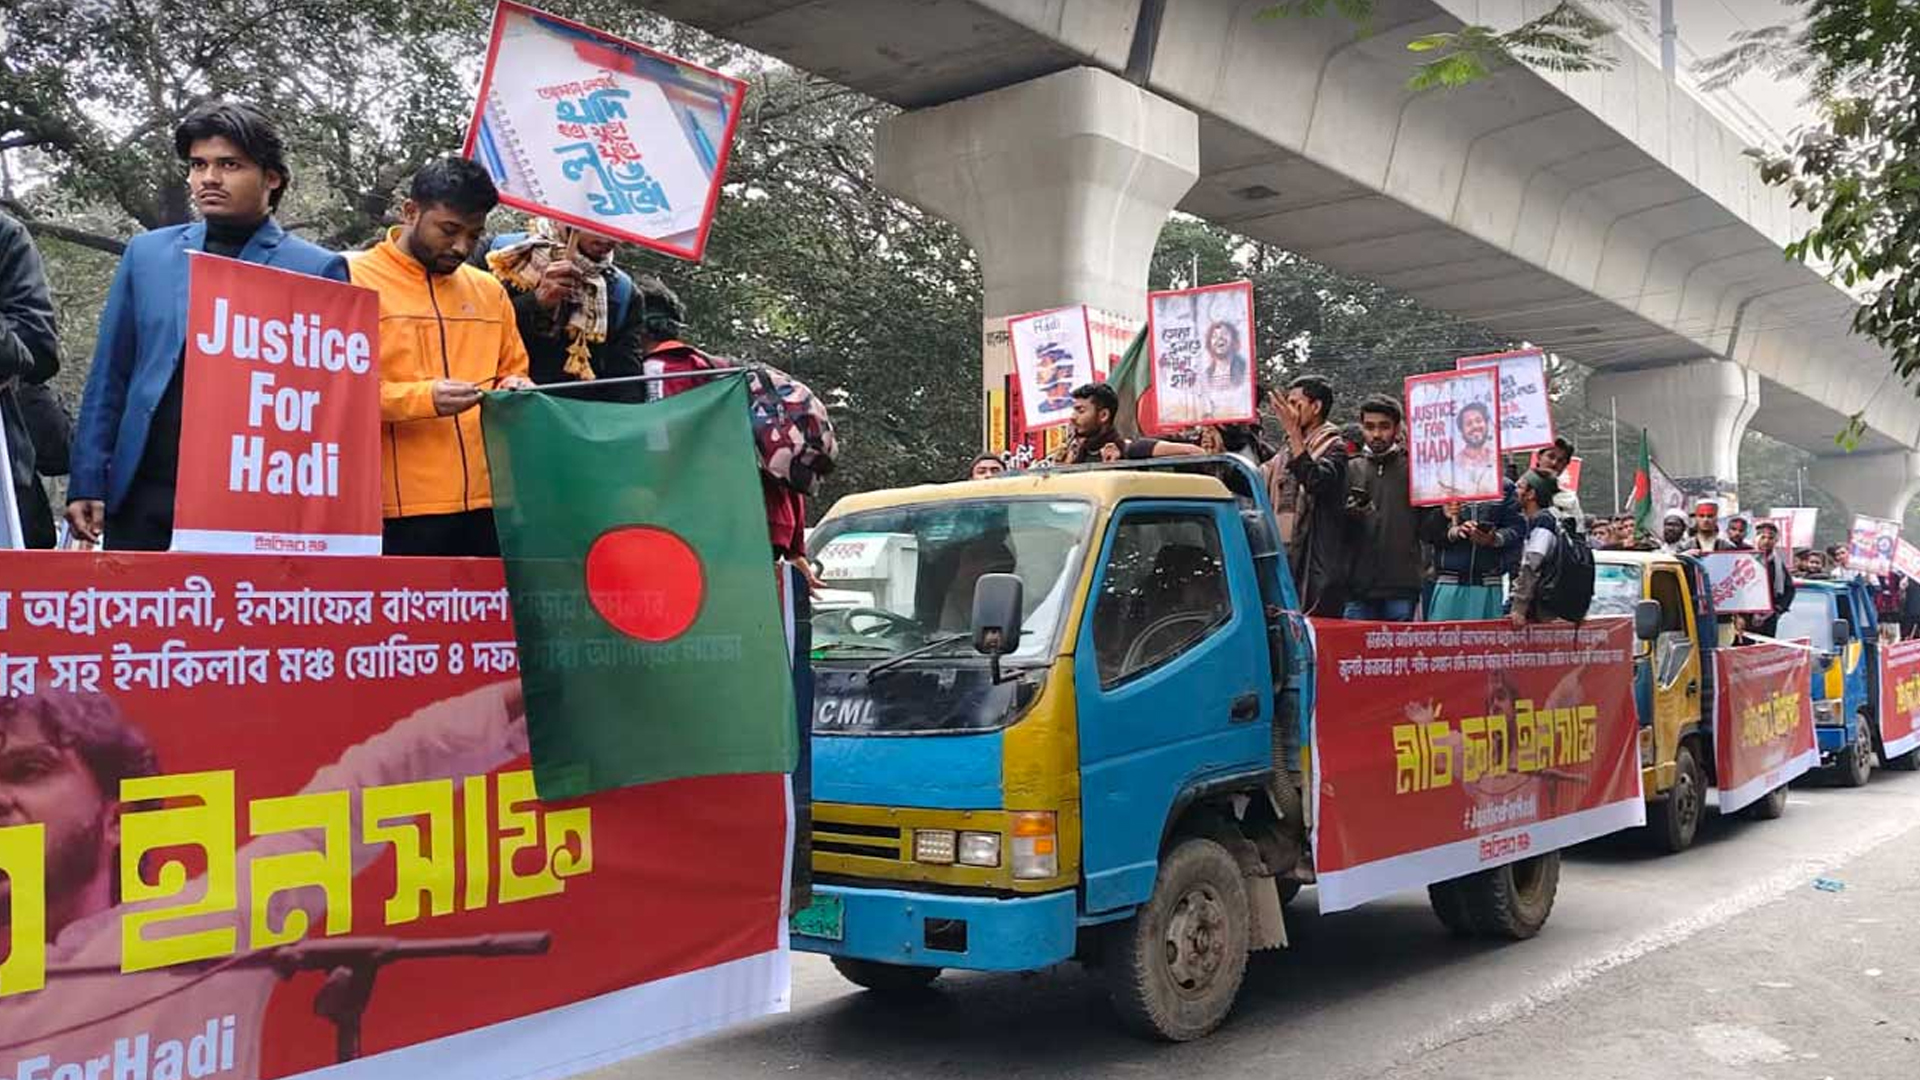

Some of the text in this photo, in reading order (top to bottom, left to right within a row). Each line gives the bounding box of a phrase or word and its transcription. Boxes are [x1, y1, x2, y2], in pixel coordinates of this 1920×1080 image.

[196, 297, 371, 374] Justice
[248, 370, 321, 433] For
[1412, 400, 1458, 423] JUSTICE
[1424, 421, 1446, 438] FOR
[229, 434, 341, 498] Hadi
[1415, 438, 1455, 464] HADI
[21, 575, 226, 635] অগ্রসেনানী,
[235, 581, 374, 626] ইনসাফের
[380, 587, 510, 623] বাংলাদেশ
[48, 654, 103, 693] সহ
[111, 639, 270, 690] ইনকিলাব
[278, 646, 335, 683] মঞ্চ
[345, 633, 440, 680] ঘোষিত
[448, 643, 465, 675] ৪
[1392, 703, 1453, 795] মার্চ
[1515, 699, 1597, 771] ইনসাফ
[119, 769, 593, 974] ইনসাফ
